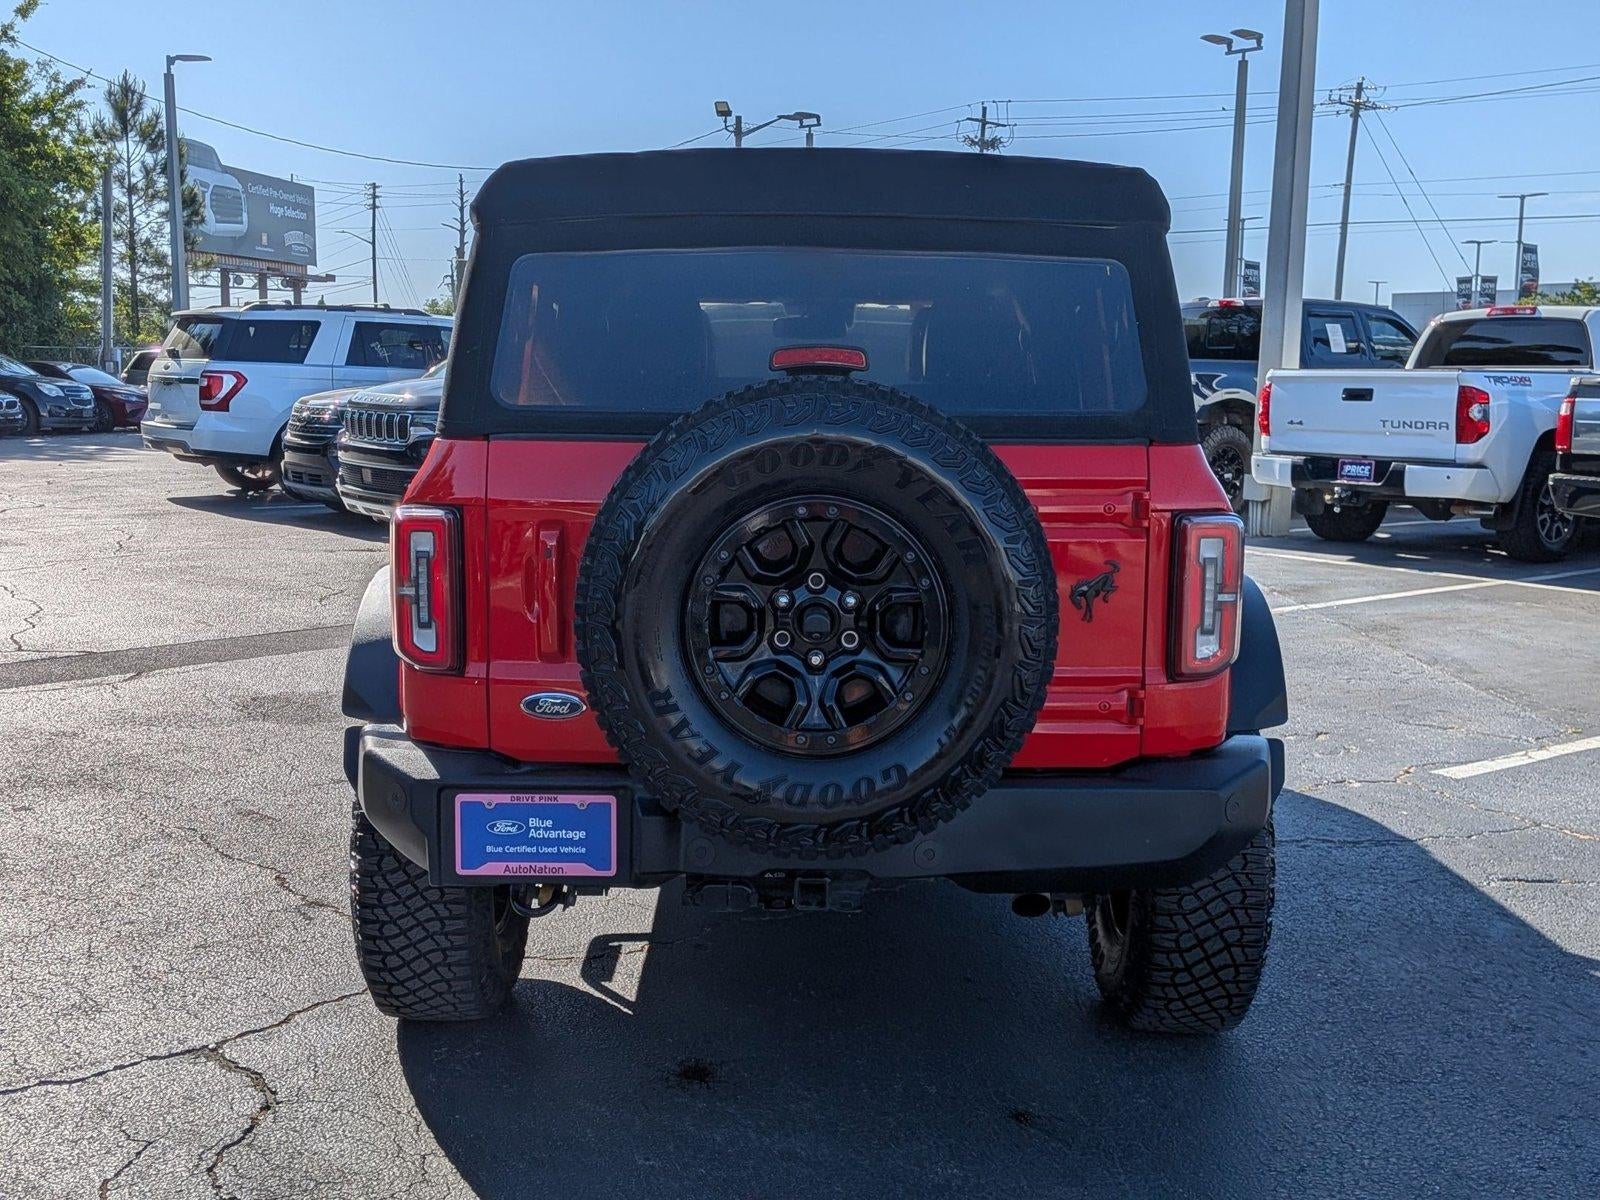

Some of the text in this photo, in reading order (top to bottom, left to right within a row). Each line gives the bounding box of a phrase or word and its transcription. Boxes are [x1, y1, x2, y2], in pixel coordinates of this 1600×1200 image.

[269, 202, 307, 220] Huge Selection
[1522, 252, 1537, 262] NEW
[1245, 268, 1259, 277] NEW
[1480, 282, 1496, 290] NEW
[1379, 419, 1450, 431] TUNDRA
[1345, 464, 1371, 475] PRICE
[535, 698, 571, 715] Ford
[493, 821, 518, 833] Ford
[528, 817, 554, 828] Blue
[528, 828, 586, 841] Advantage
[486, 845, 586, 854] Blue Certified Used Vehicle
[503, 864, 565, 875] AutoNation
